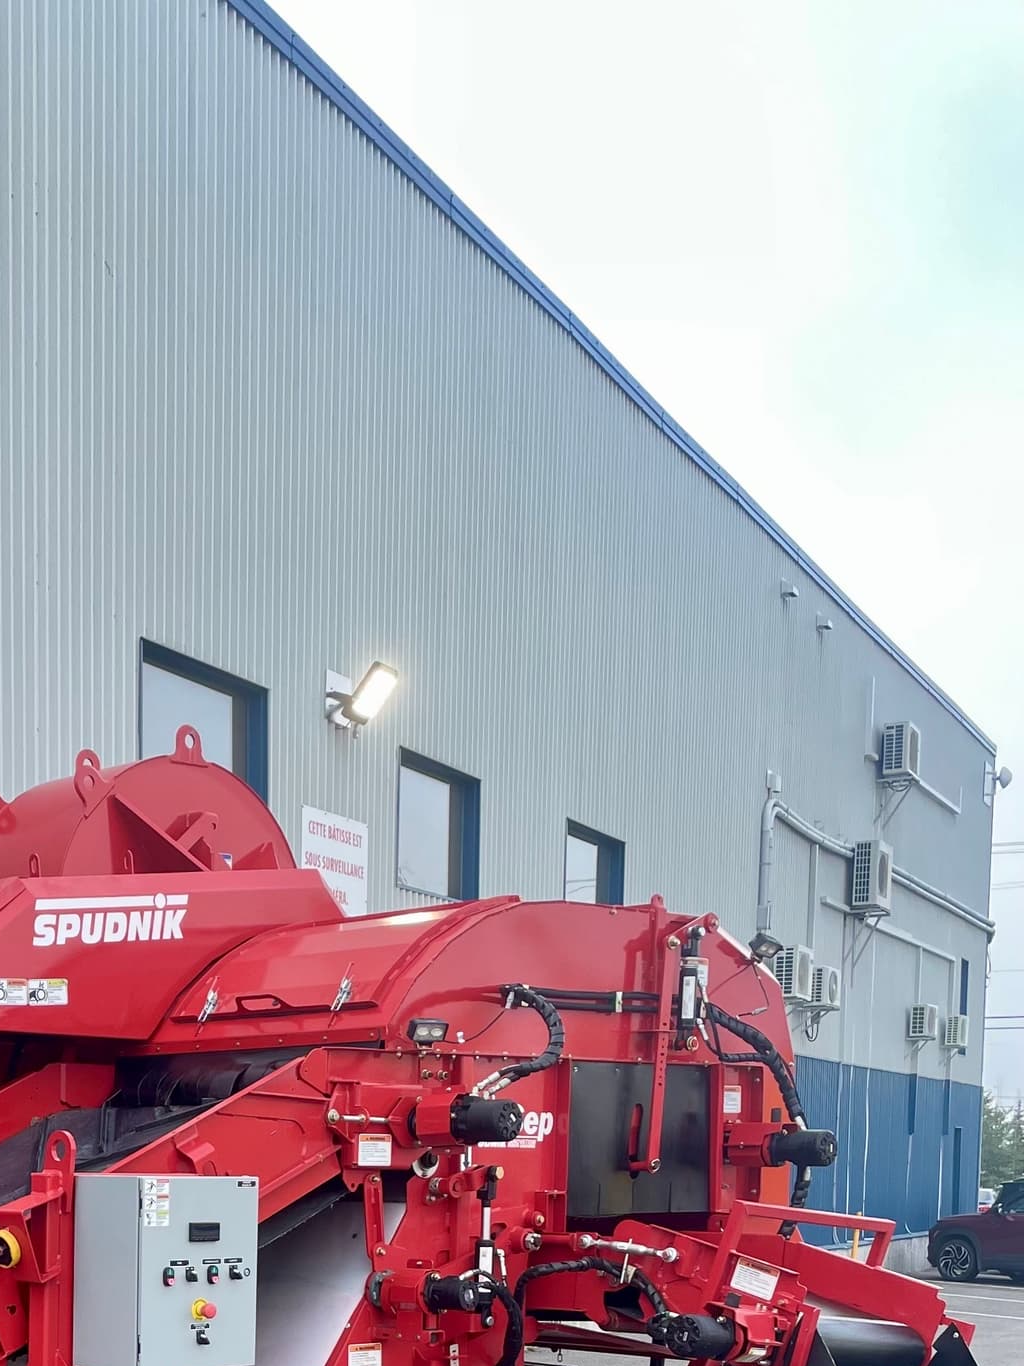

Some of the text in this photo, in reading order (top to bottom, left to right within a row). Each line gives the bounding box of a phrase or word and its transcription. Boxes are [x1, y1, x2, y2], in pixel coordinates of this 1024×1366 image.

[308, 820, 362, 848] CETTE BÂTISSE EST
[304, 850, 364, 879] SOUS SURVEILLANCE
[32, 893, 187, 946] SPUDNIK
